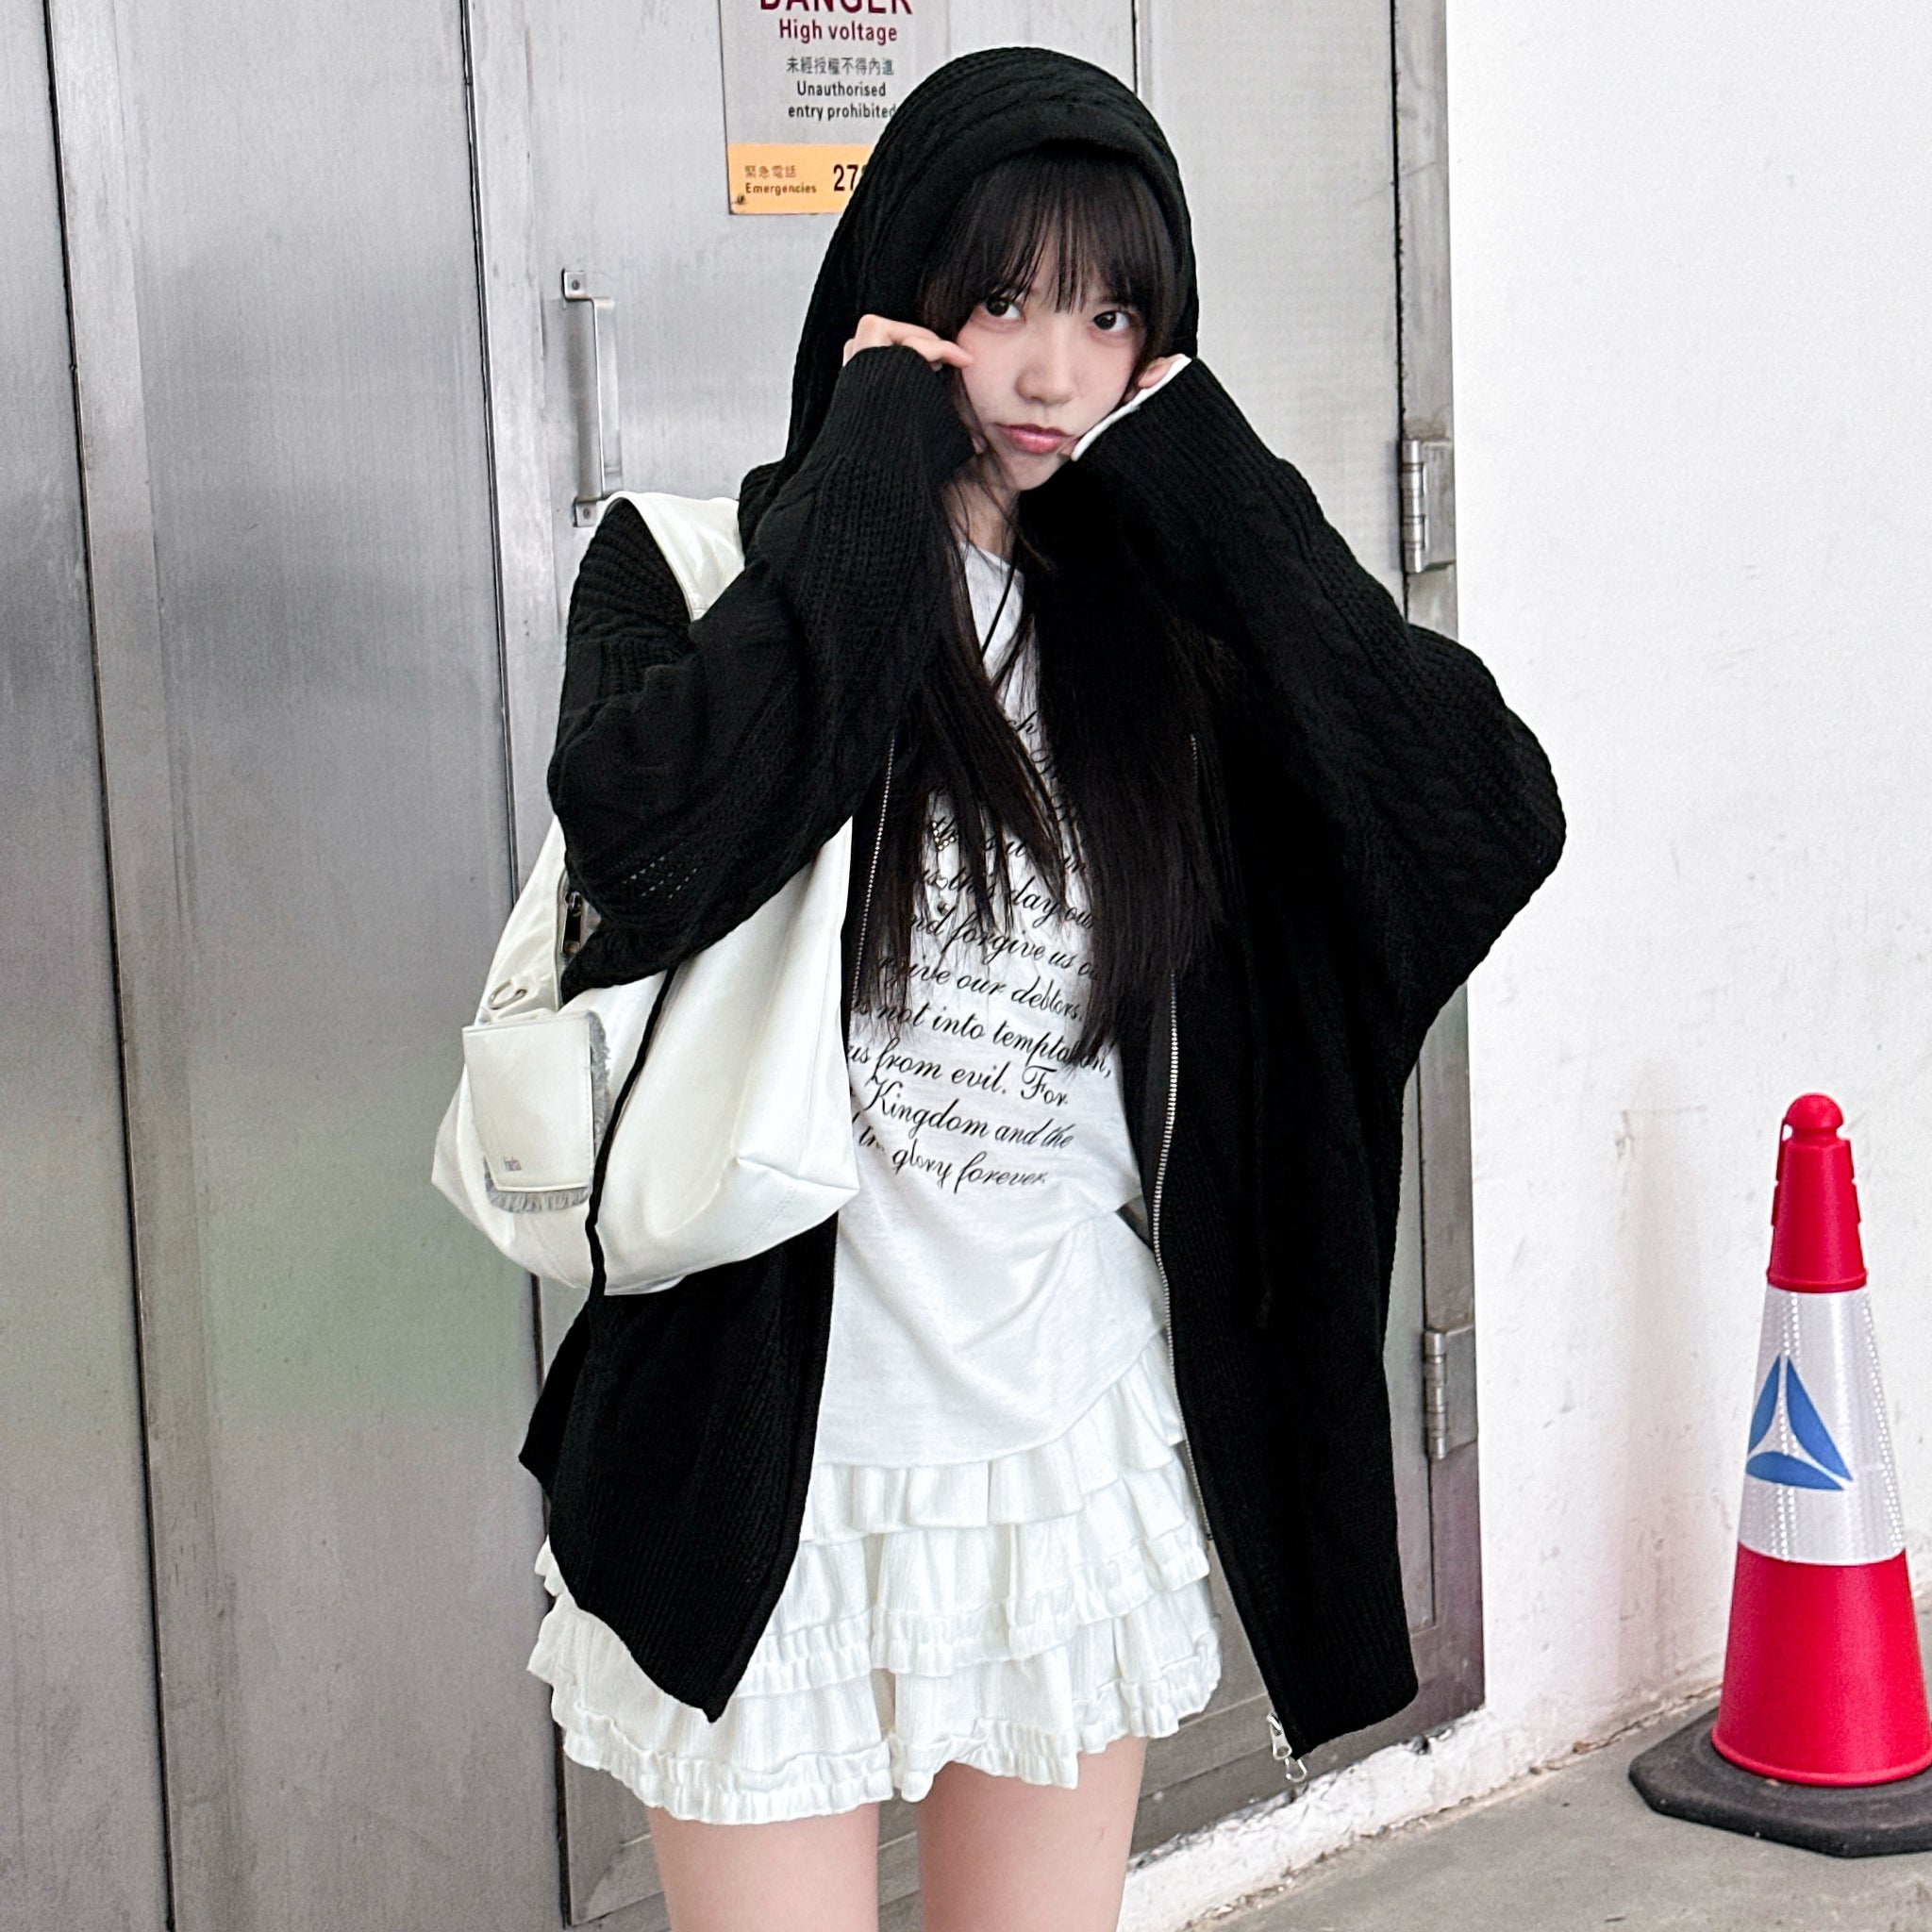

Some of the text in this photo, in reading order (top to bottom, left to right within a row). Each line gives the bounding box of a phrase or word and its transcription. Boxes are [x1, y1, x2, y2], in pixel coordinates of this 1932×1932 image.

[779, 19, 898, 46] High voltage
[797, 80, 887, 96] Unauthorised
[788, 104, 824, 121] entry
[744, 165, 796, 178] 緊急電話
[833, 164, 866, 192] 27
[745, 182, 817, 196] Emergencies
[941, 911, 1045, 965] forgive
[1050, 950, 1074, 970] us
[957, 974, 1007, 996] our
[877, 1002, 931, 1026] not
[932, 1006, 986, 1040] into
[876, 1038, 942, 1078] from
[951, 1061, 1007, 1094] evil.
[1020, 1065, 1068, 1107] For
[864, 1075, 989, 1140] Kingdom
[994, 1118, 1053, 1146] and
[1041, 1124, 1076, 1149] the
[891, 1139, 952, 1189] glory
